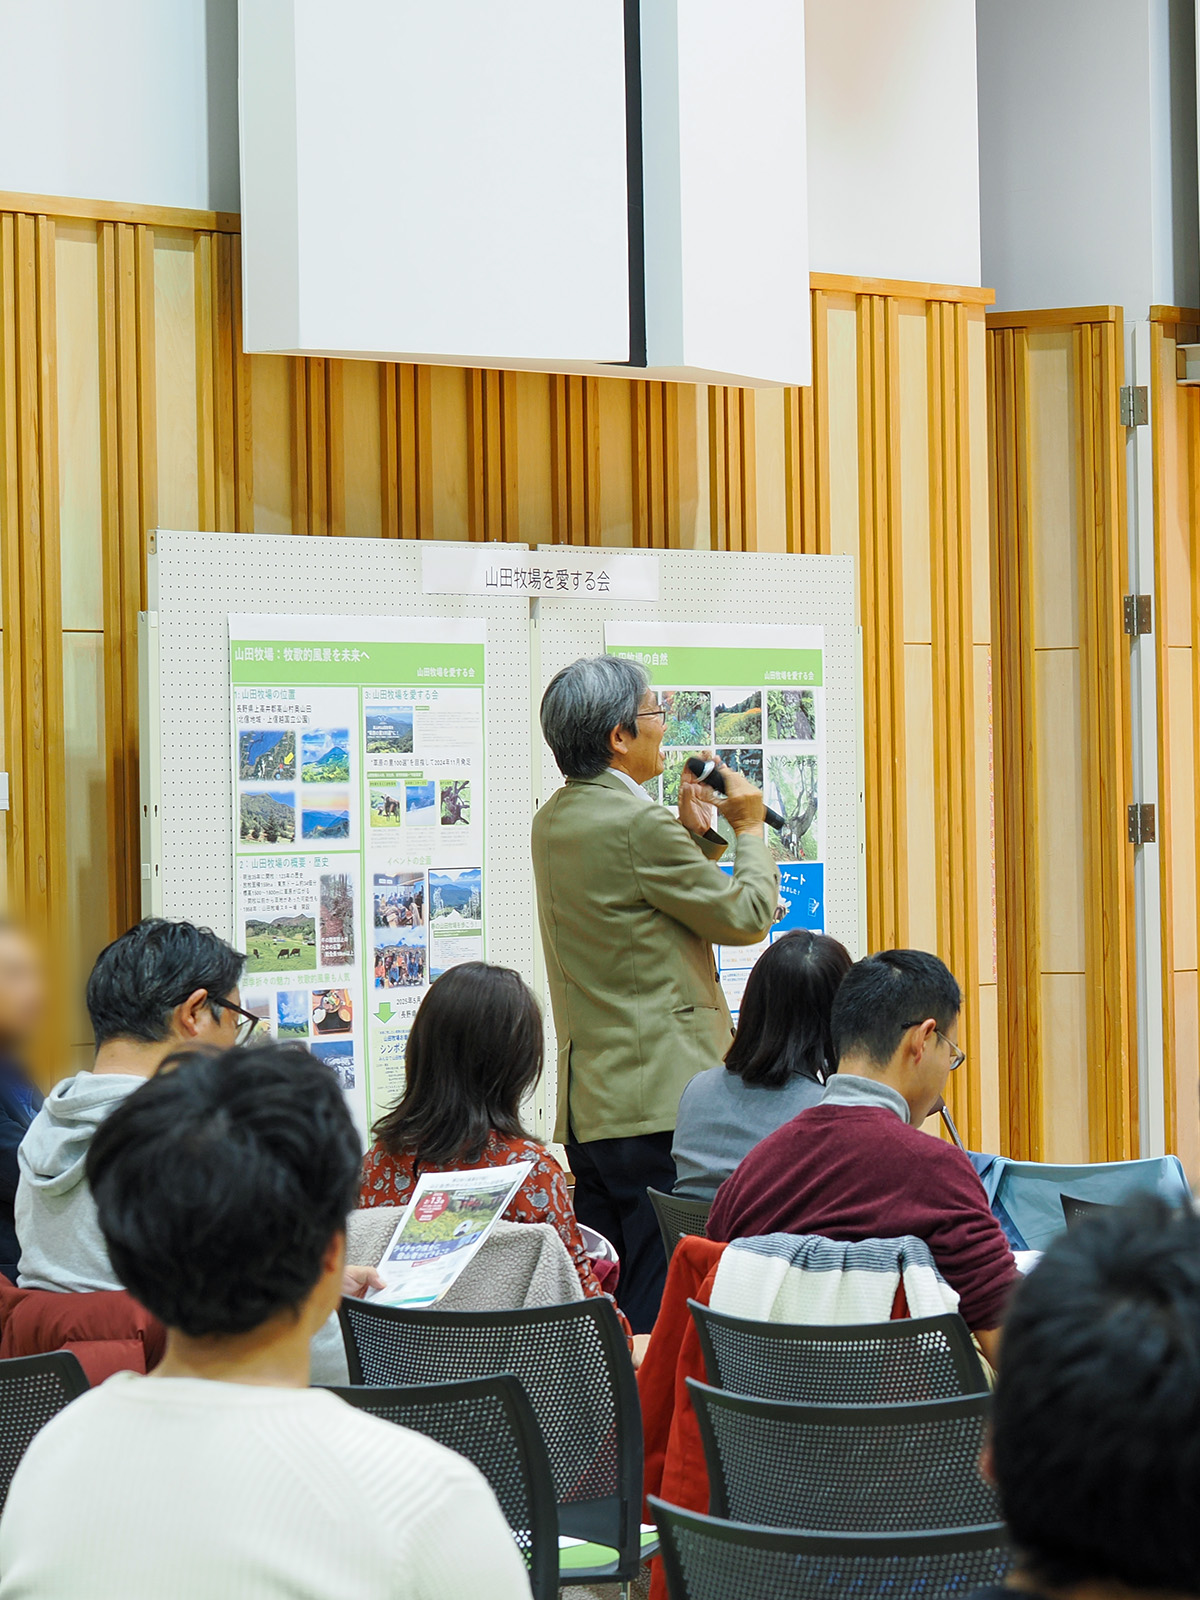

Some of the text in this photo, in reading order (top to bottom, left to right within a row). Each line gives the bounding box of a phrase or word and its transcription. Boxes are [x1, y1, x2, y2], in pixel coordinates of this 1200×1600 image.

[485, 566, 611, 592] 山田牧場を愛する会
[417, 667, 476, 678] 山田牧場を愛する会
[764, 671, 815, 681] 山田牧場を愛する会
[780, 871, 806, 885] ケート
